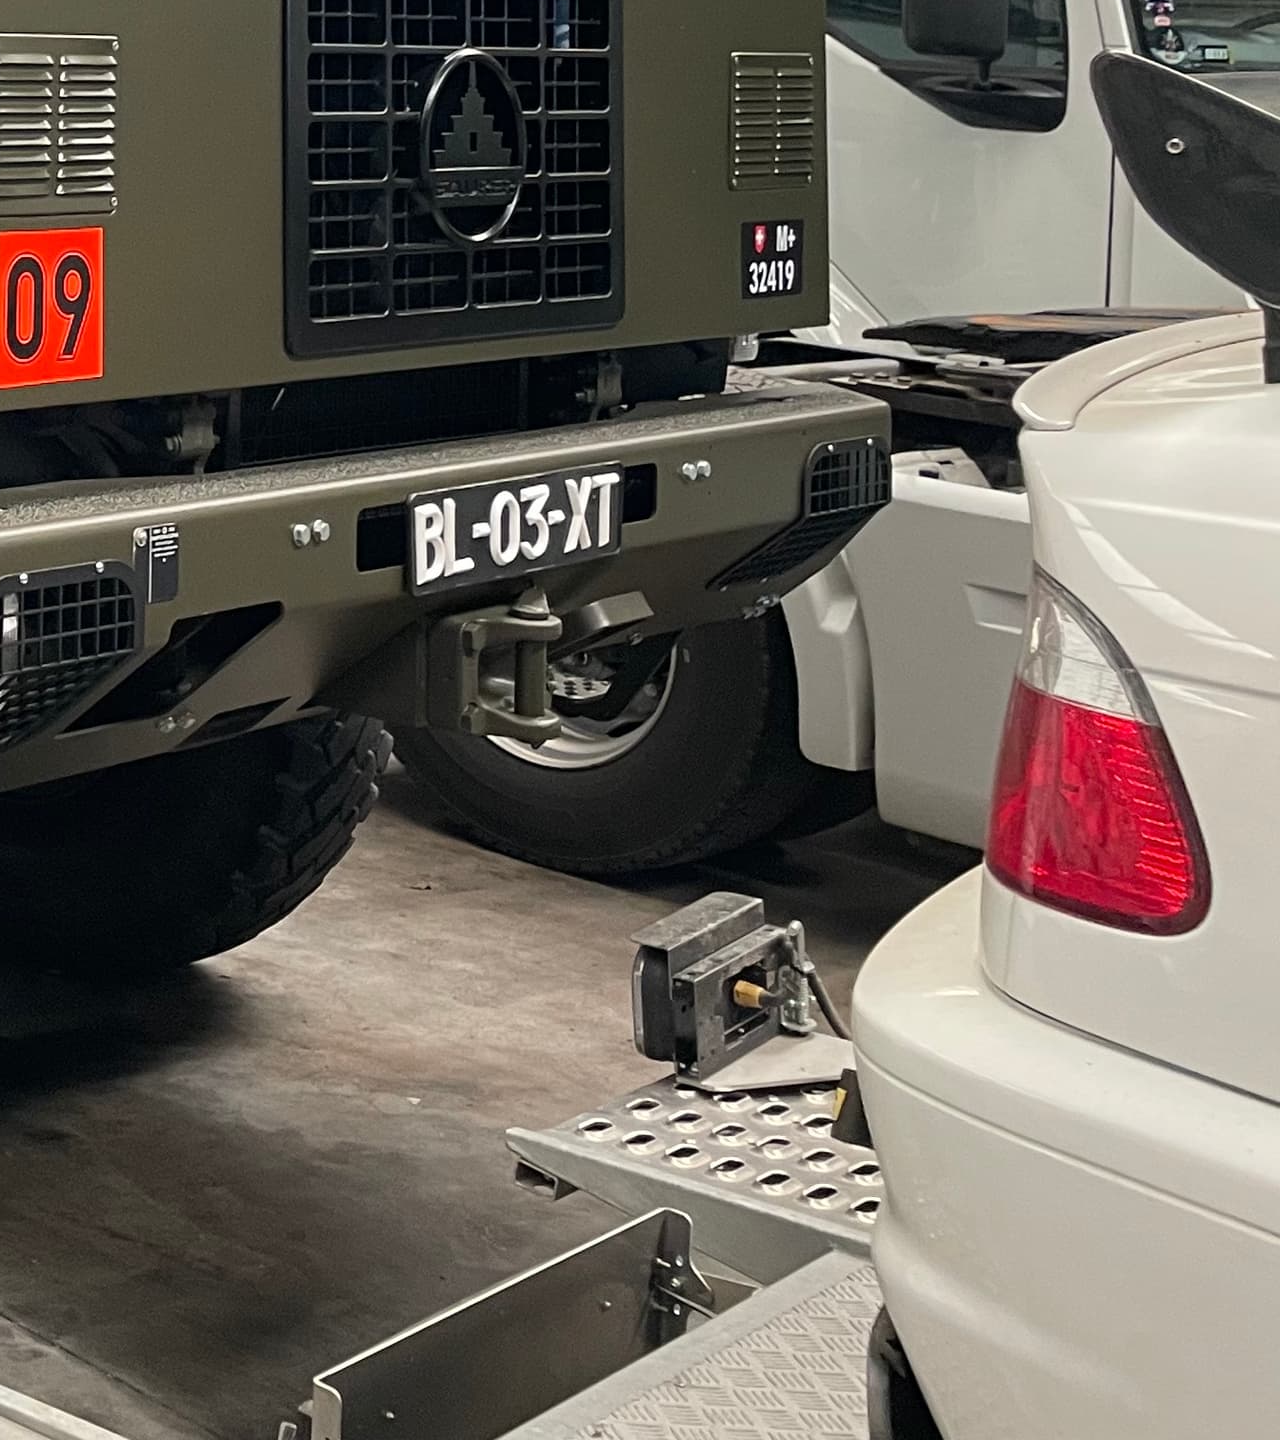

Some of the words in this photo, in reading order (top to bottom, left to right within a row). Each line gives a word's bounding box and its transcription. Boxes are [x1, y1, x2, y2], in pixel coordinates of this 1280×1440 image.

[5, 252, 92, 363] 09
[748, 259, 795, 294] 32419
[413, 471, 621, 586] BL-03-XT
